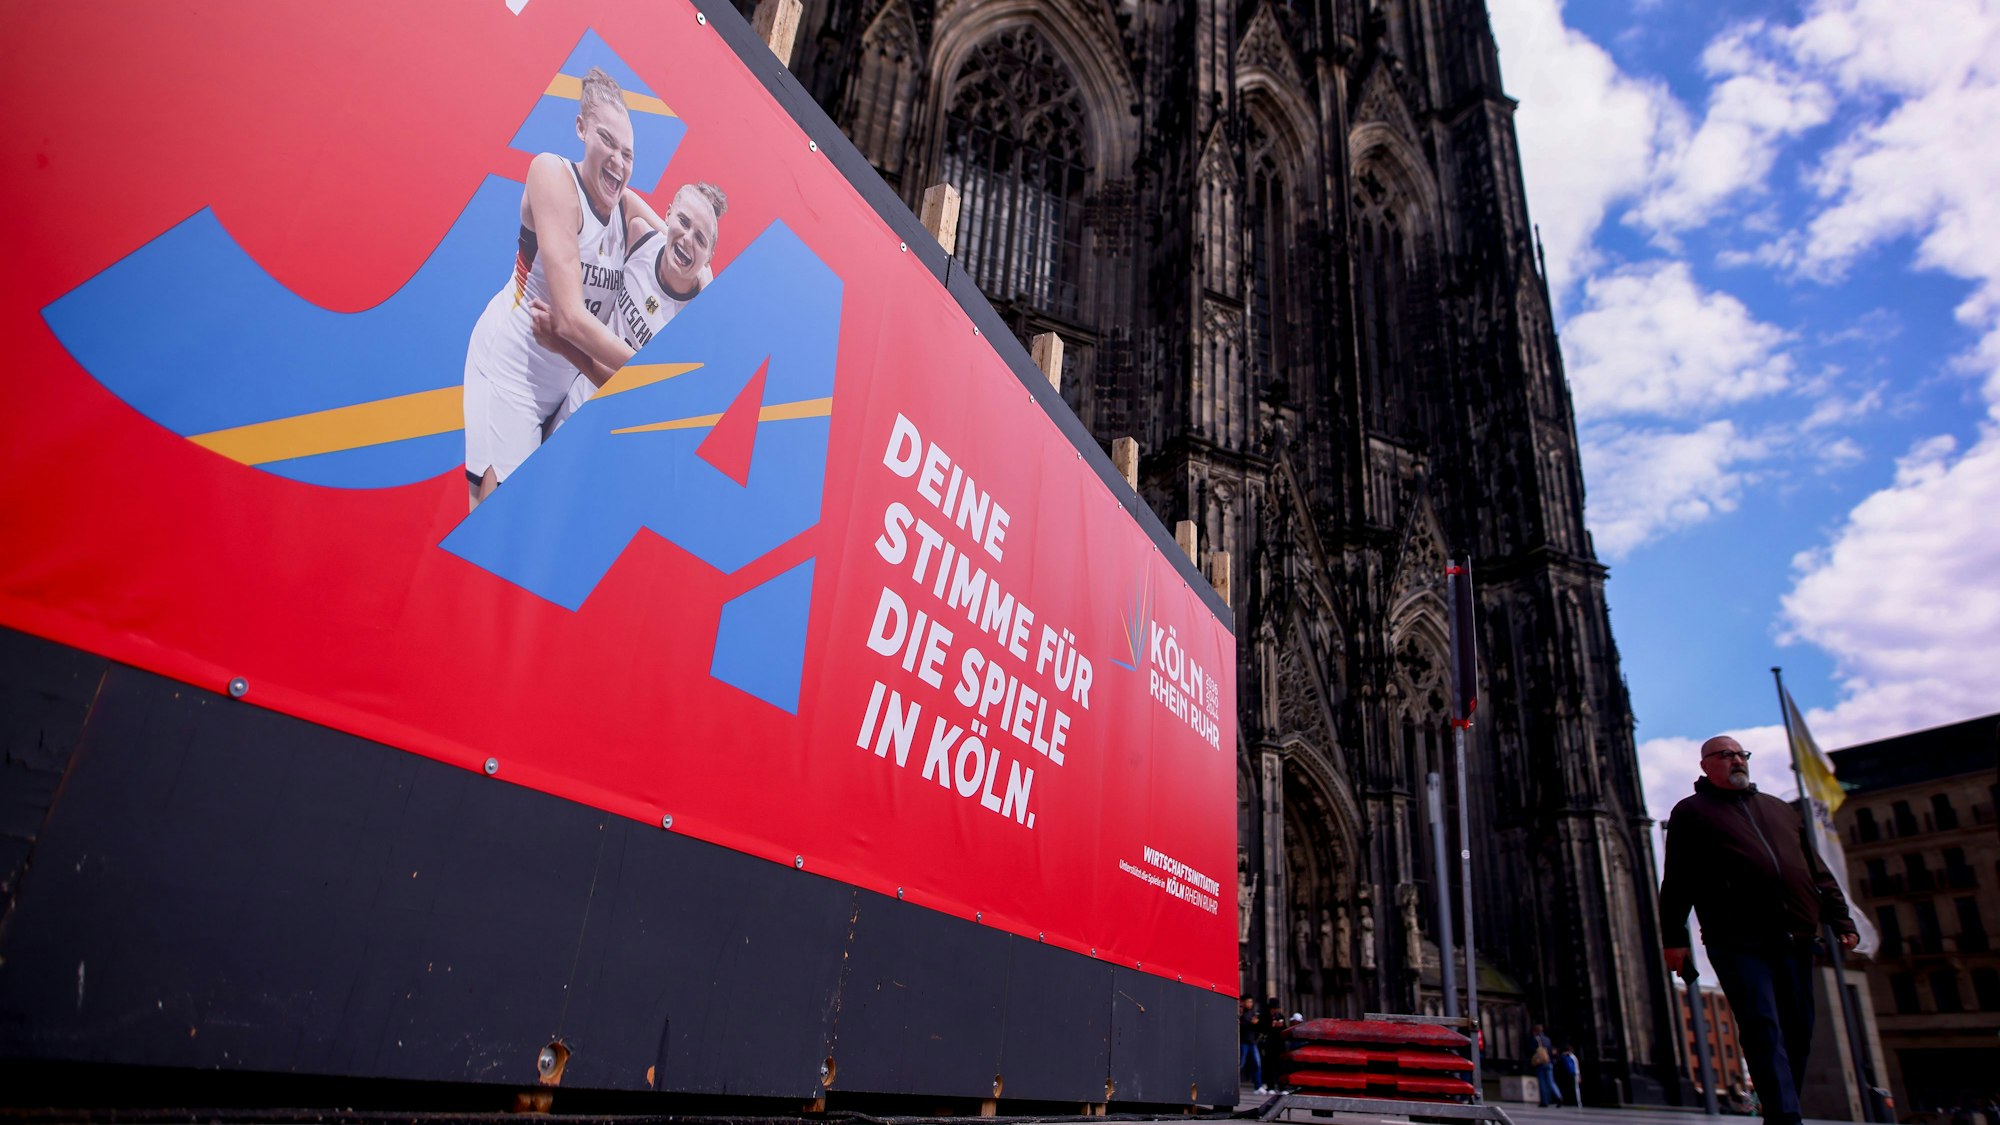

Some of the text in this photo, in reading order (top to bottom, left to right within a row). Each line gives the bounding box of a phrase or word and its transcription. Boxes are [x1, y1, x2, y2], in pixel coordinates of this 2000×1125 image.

[40, 27, 844, 717] JA
[882, 412, 1011, 563] DEINE
[866, 586, 1071, 767] DIE SPIELE
[875, 501, 1094, 711] STIMME FÜR
[1150, 620, 1204, 705] KÖLN
[856, 680, 1036, 829] IN KÖLN.
[1150, 668, 1220, 751] RHEIN RUHR
[1143, 845, 1220, 897] WIRTSCHAFTSINITIATIVE
[1165, 876, 1185, 899] KÖLN
[1184, 886, 1203, 908] RHEIN
[1202, 895, 1218, 915] RUHR
